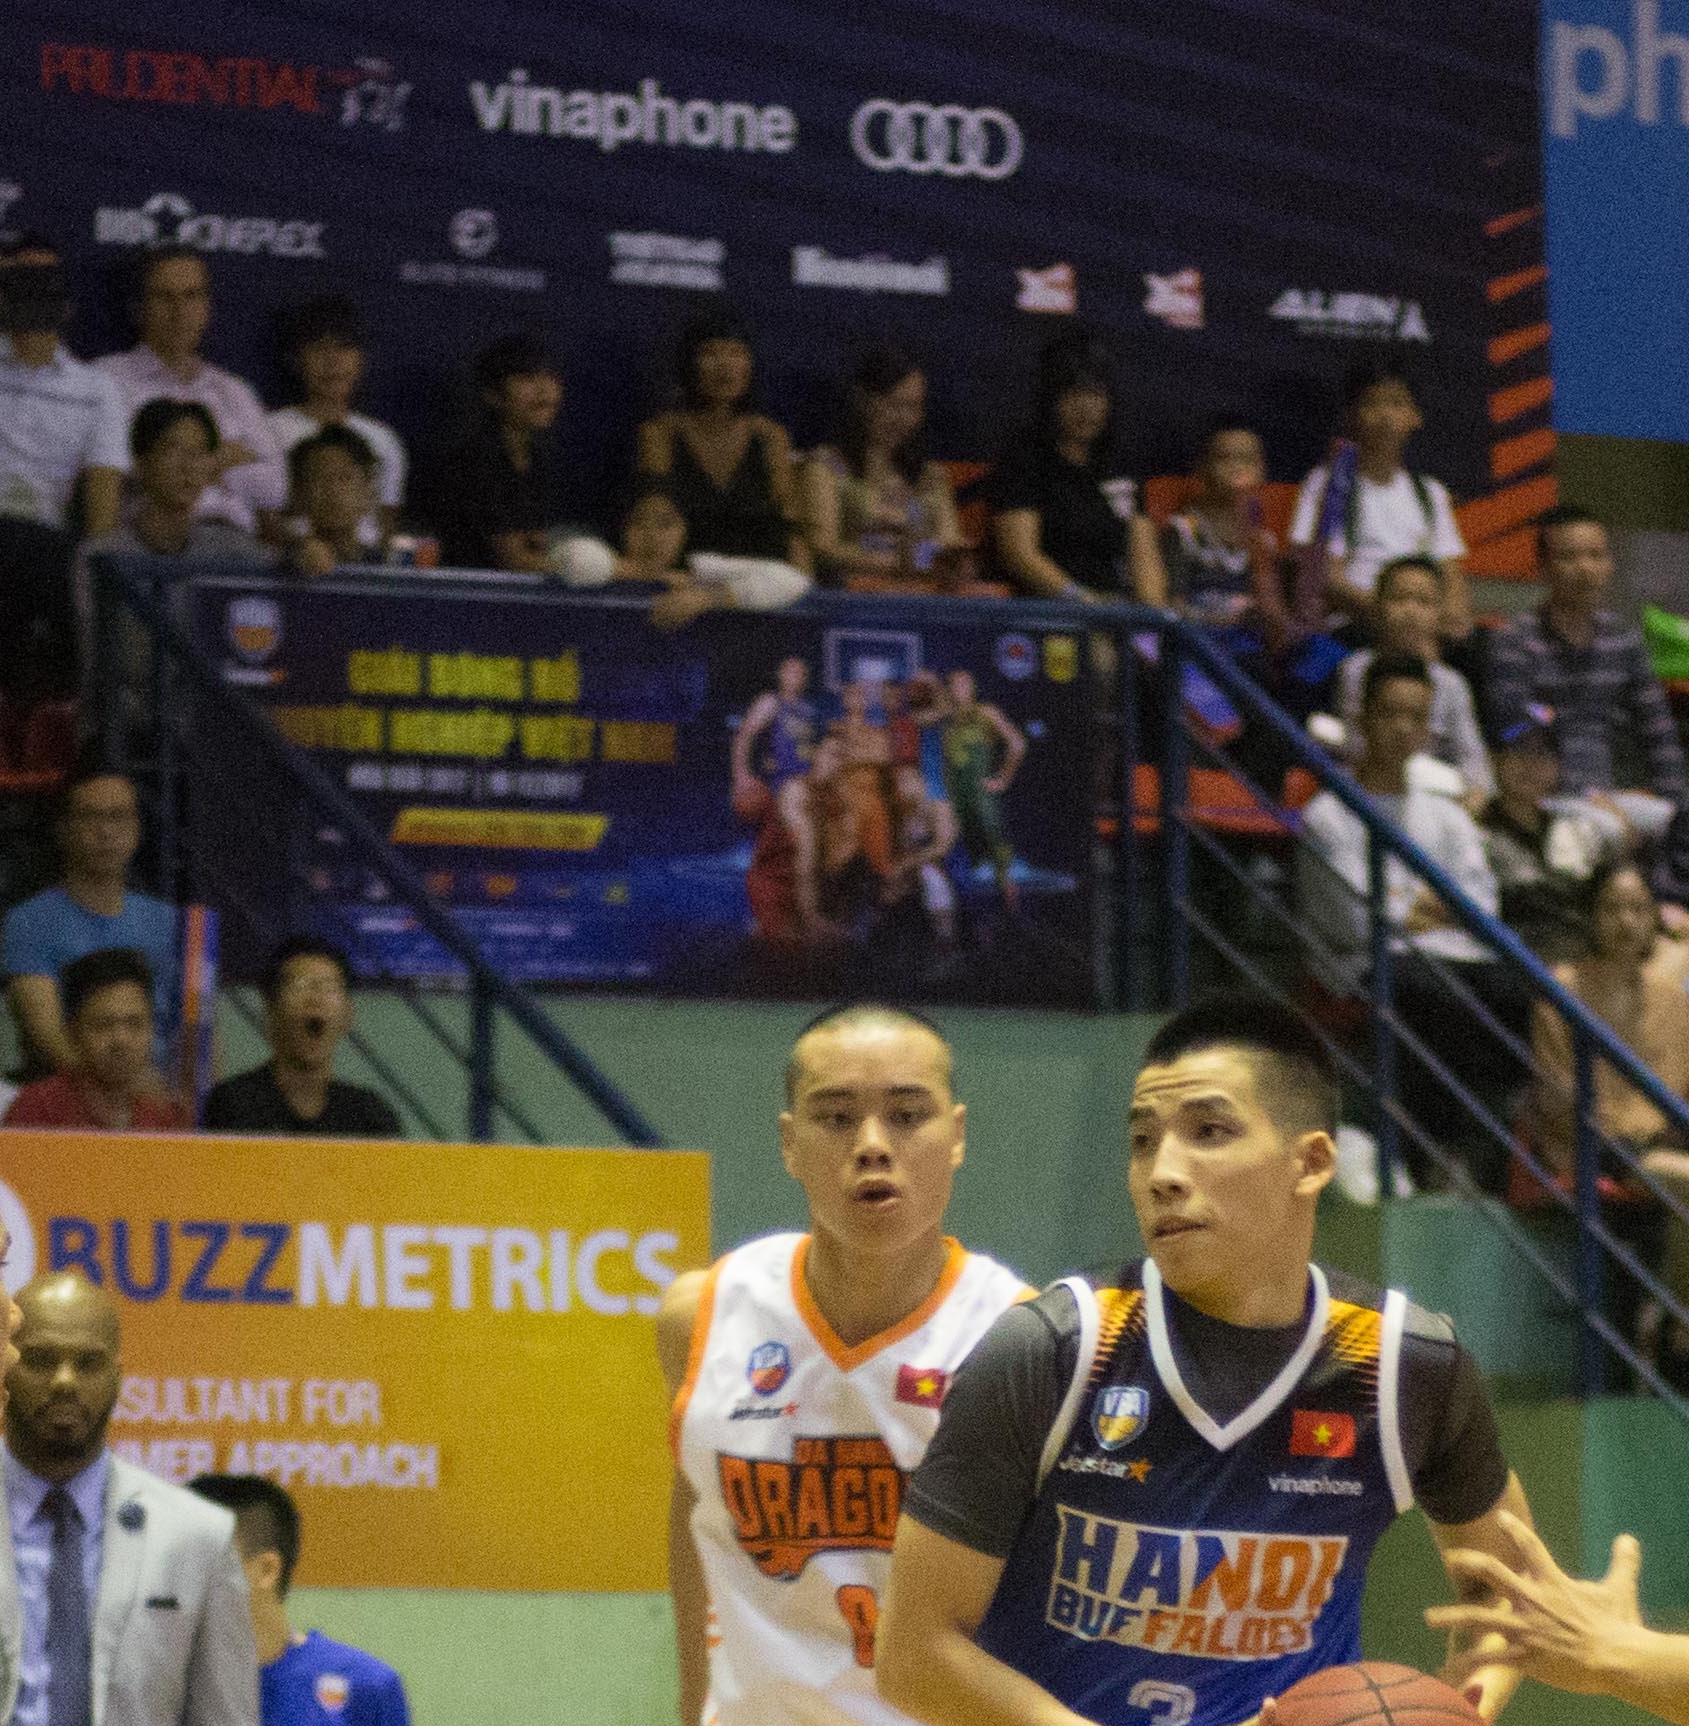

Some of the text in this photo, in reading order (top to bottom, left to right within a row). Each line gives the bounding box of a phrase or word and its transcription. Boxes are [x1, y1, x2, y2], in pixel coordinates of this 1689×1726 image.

[469, 69, 796, 156] vinaphone
[47, 1217, 681, 1315] BUZZMETRICS
[303, 1378, 382, 1431] FOR
[223, 1439, 439, 1489] APPROACH
[1058, 1506, 1347, 1613] HANOI
